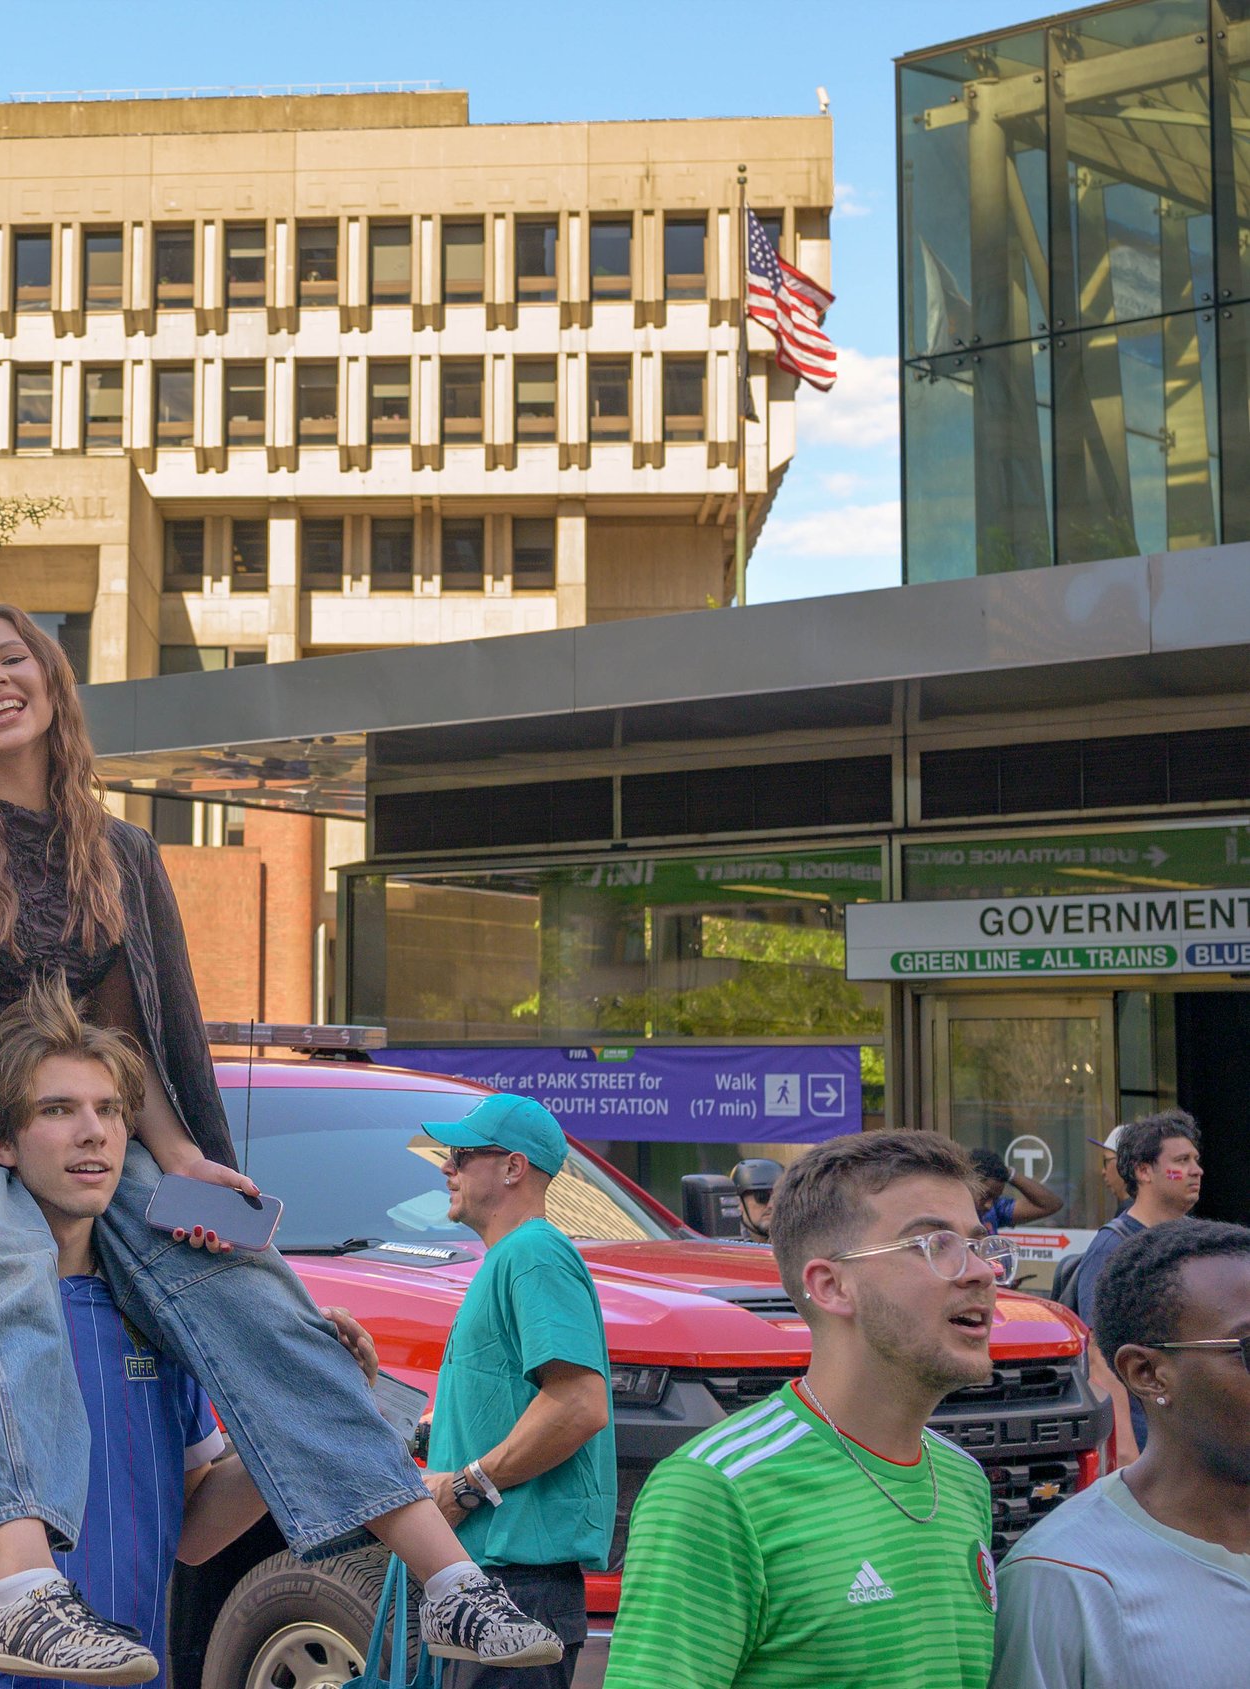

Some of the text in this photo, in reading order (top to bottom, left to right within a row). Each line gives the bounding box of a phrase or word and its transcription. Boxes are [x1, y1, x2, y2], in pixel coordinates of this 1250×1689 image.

[899, 952, 969, 972] GREEN
[975, 951, 1021, 970] LINE
[1041, 949, 1080, 968] ALL
[1086, 946, 1168, 968] TRAINS
[1195, 944, 1250, 965] BLUE
[569, 1048, 588, 1059] FIFA
[518, 1074, 534, 1089] at
[537, 1073, 577, 1089] PARK
[581, 1073, 635, 1090] STREET
[639, 1072, 662, 1090] for
[715, 1073, 757, 1090] Walk
[543, 1097, 668, 1115] SOUTH STATION
[690, 1099, 715, 1118] (17
[720, 1099, 757, 1119] min)
[1013, 1148, 1044, 1179] T
[1032, 1249, 1053, 1259] PUSH
[847, 1586, 894, 1603] adidas
